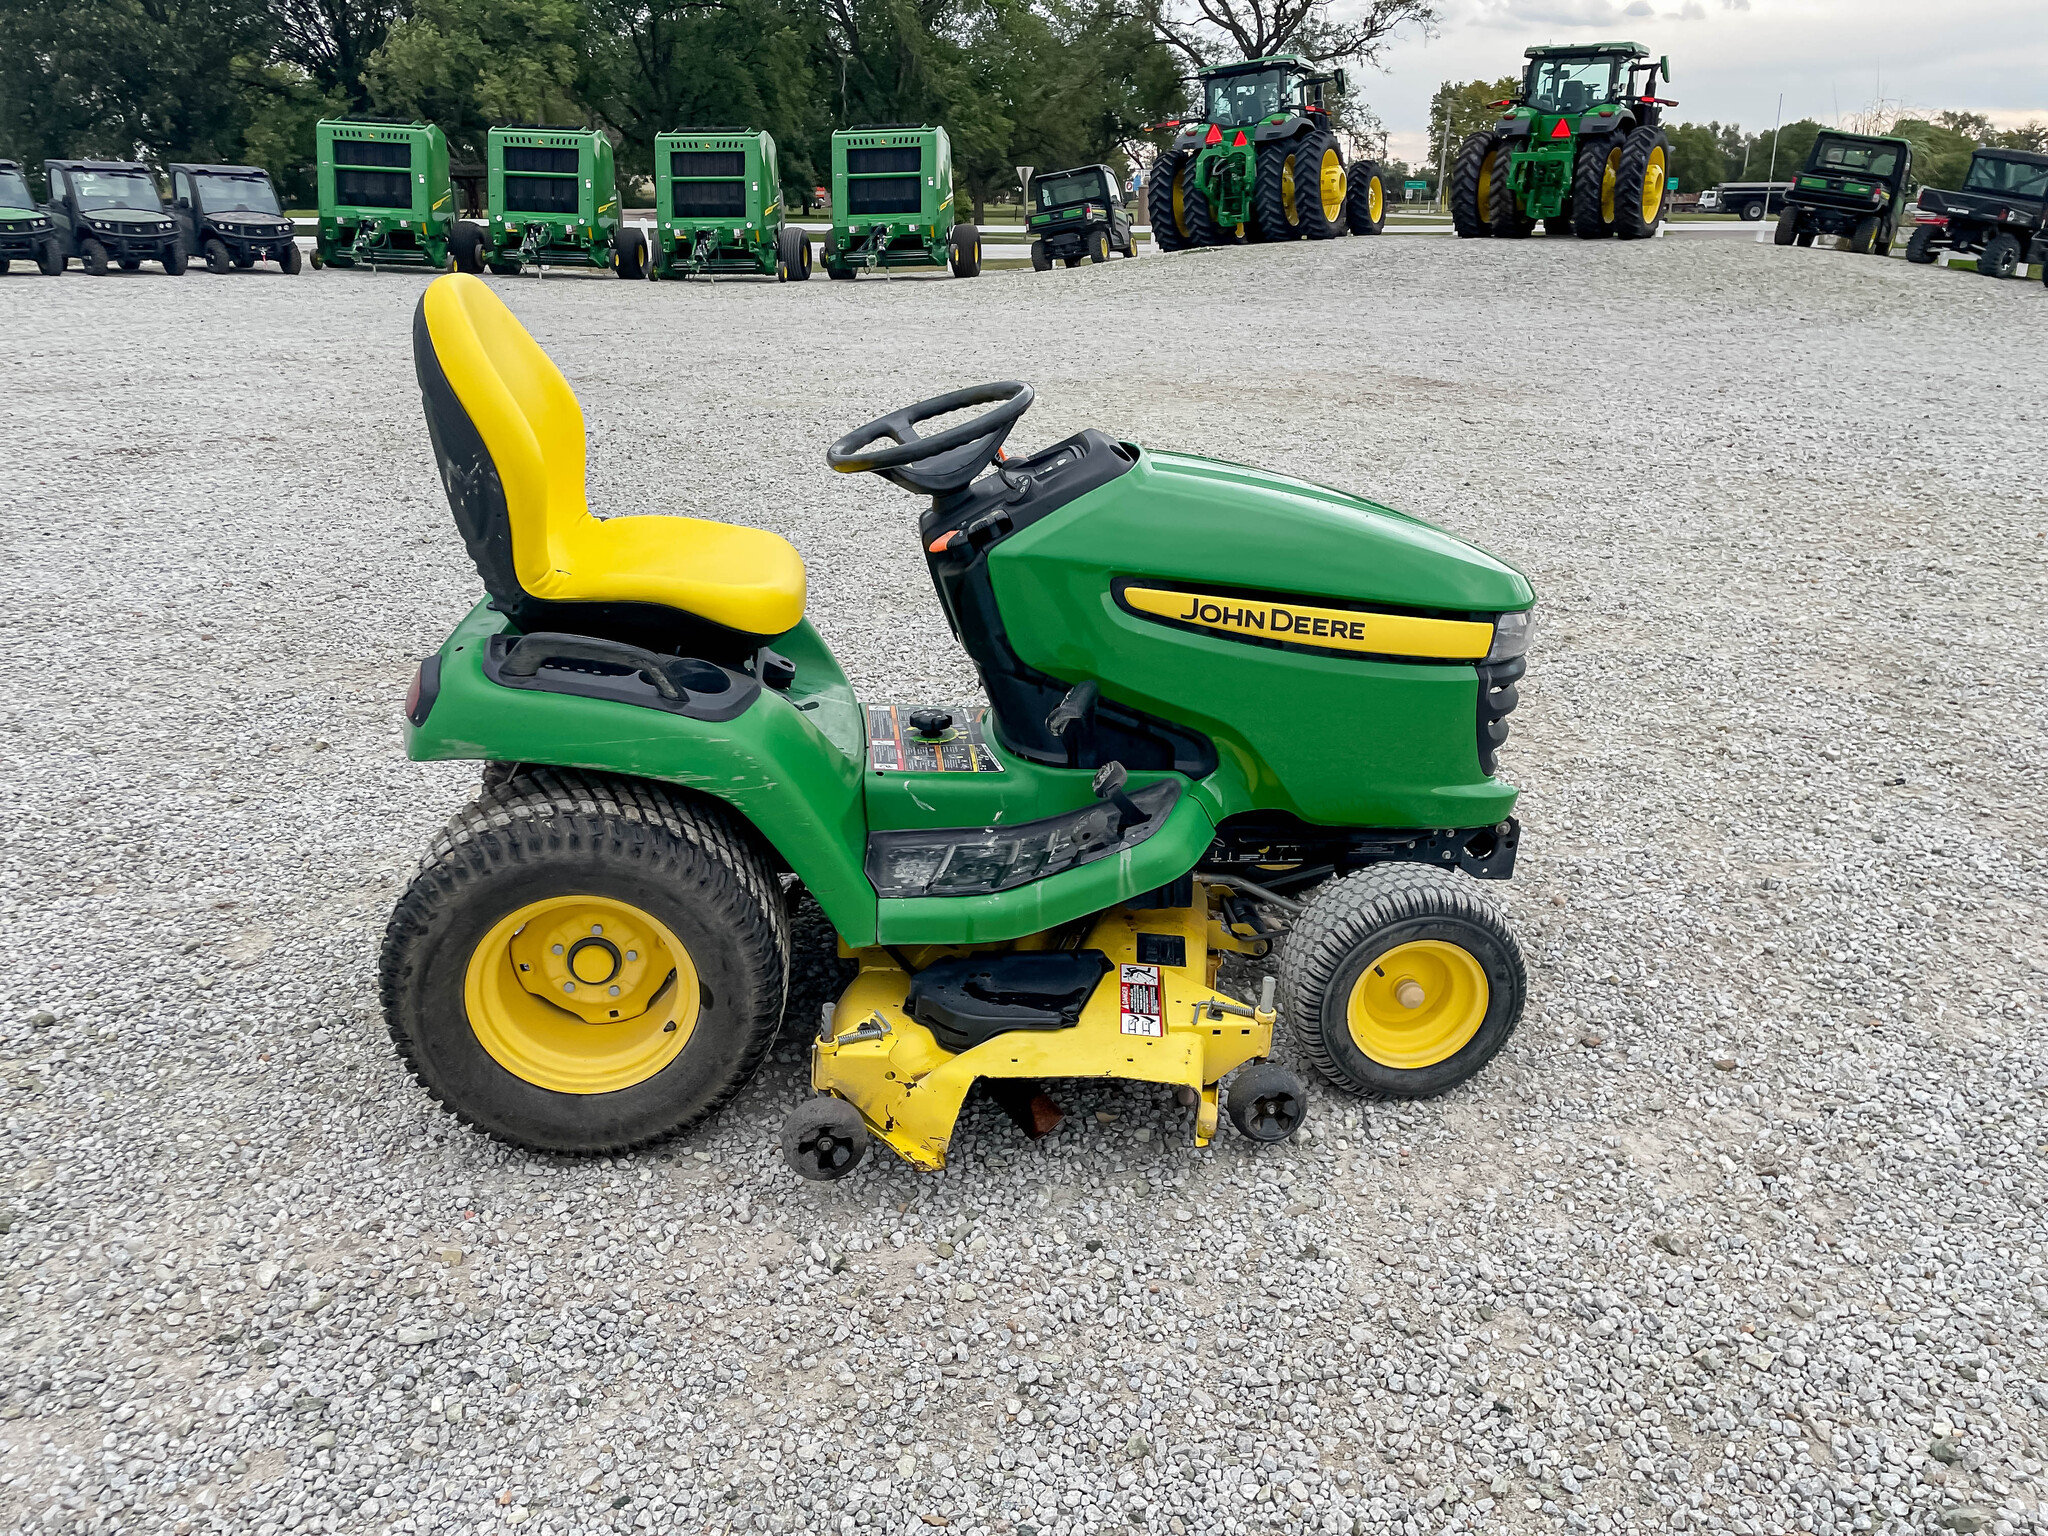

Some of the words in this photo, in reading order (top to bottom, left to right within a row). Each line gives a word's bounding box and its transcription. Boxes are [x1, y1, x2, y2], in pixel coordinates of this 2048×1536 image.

[1180, 598, 1265, 630] JOHN
[1270, 608, 1366, 640] DEERE
[1121, 986, 1129, 1005] DANGER
